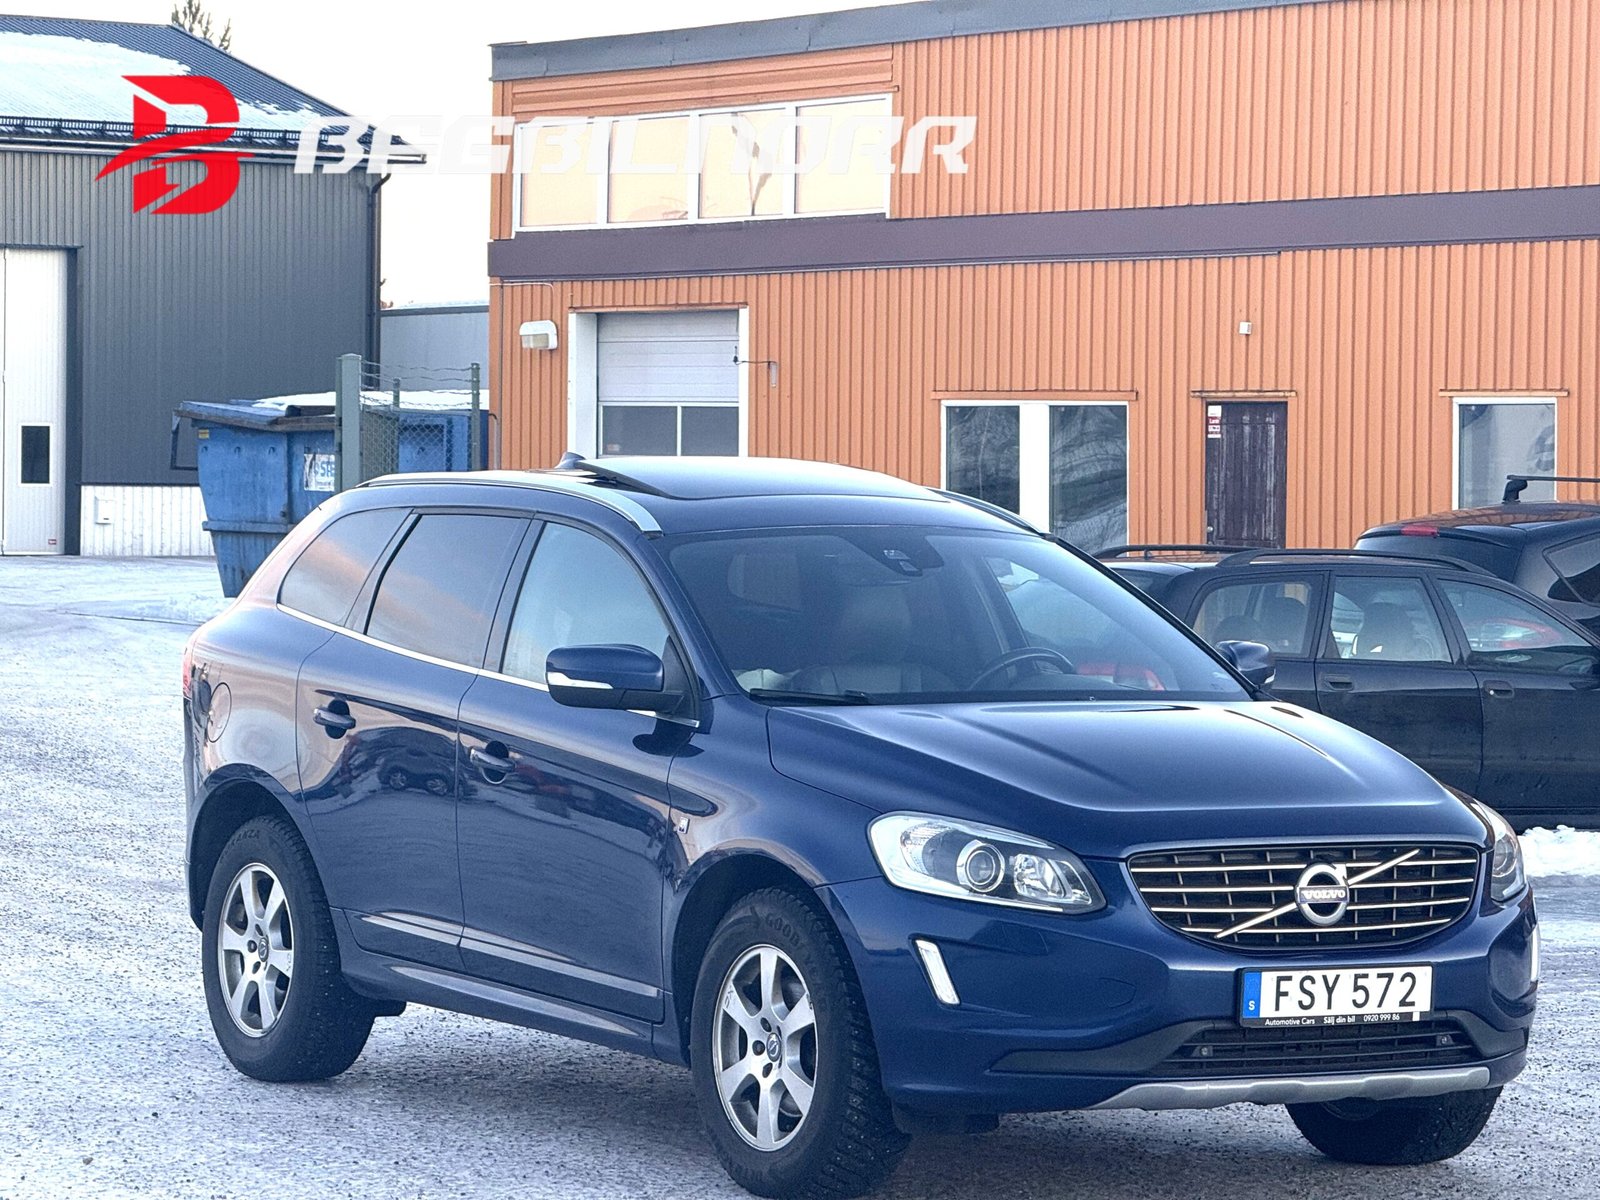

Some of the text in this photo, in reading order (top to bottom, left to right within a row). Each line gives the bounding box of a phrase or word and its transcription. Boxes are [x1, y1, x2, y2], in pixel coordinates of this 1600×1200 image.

[1301, 889, 1346, 900] VOLVO
[1274, 972, 1417, 1012] FSY 572
[1248, 1000, 1256, 1011] S
[1264, 1013, 1400, 1026] Automotive Cars Sälj din bil 0920 999 86
